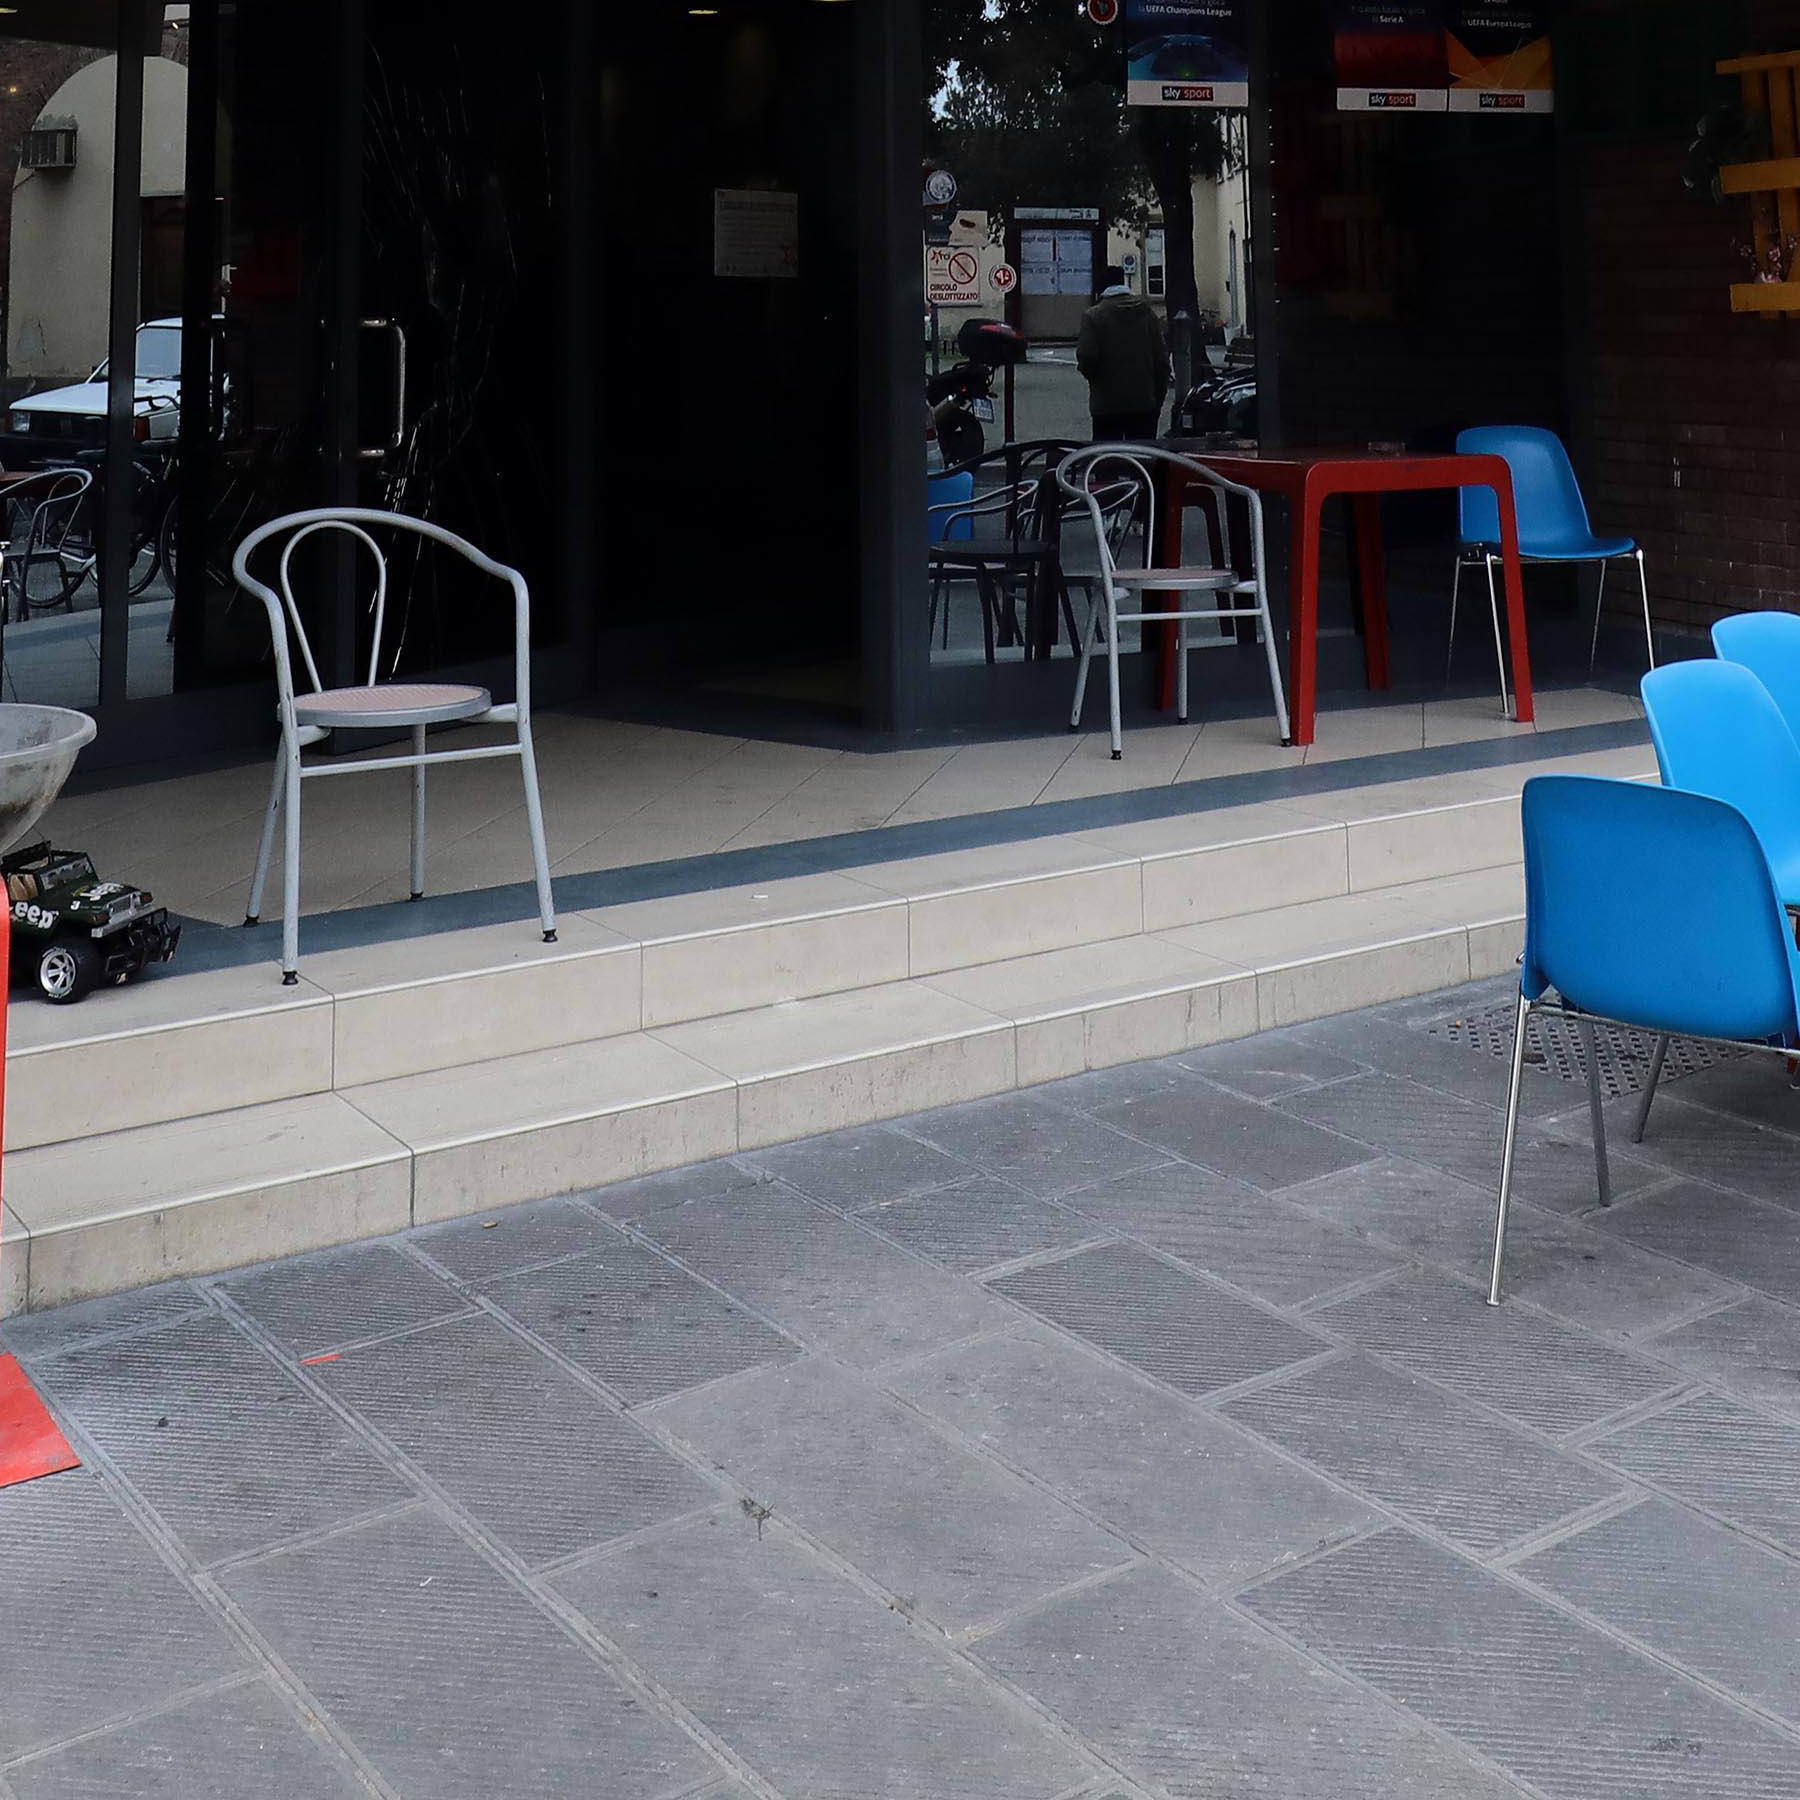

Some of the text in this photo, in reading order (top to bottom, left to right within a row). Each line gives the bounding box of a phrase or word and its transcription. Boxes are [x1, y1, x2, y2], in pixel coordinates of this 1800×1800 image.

[1166, 6, 1205, 17] Champions
[1206, 7, 1232, 18] League
[1163, 87, 1212, 101] sky sport
[1370, 94, 1414, 106] sky sport
[1480, 94, 1524, 107] sky sport
[929, 283, 958, 292] CIRCOLO
[10, 900, 56, 929] eep
